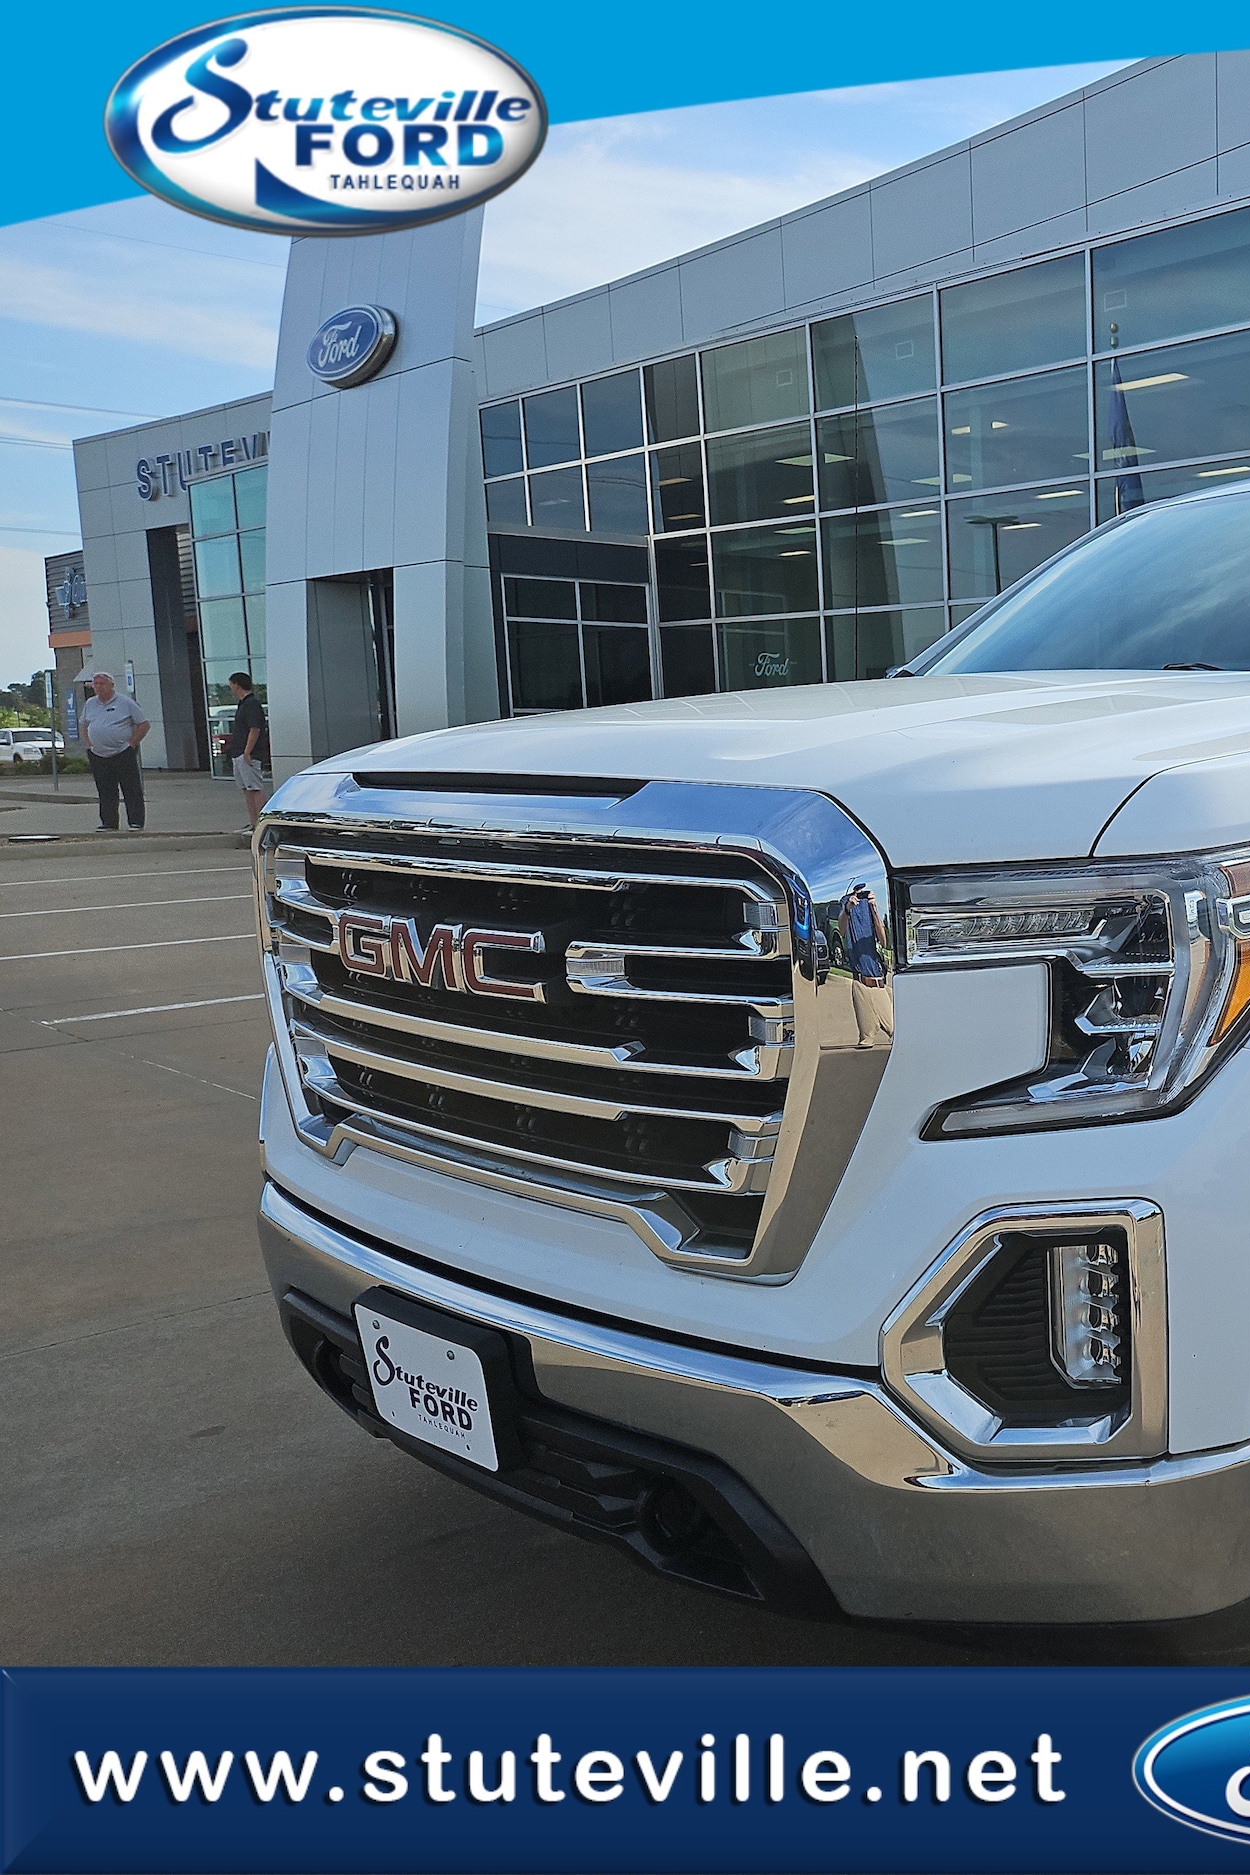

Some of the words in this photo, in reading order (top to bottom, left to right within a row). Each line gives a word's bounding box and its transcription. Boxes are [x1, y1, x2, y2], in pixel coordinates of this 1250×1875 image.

[318, 320, 362, 368] Ford
[754, 652, 790, 677] Ford
[337, 909, 547, 1004] GMC
[373, 1335, 478, 1412] Stuteville
[408, 1386, 473, 1431] FORD
[417, 1414, 466, 1440] TAHLEQUAH
